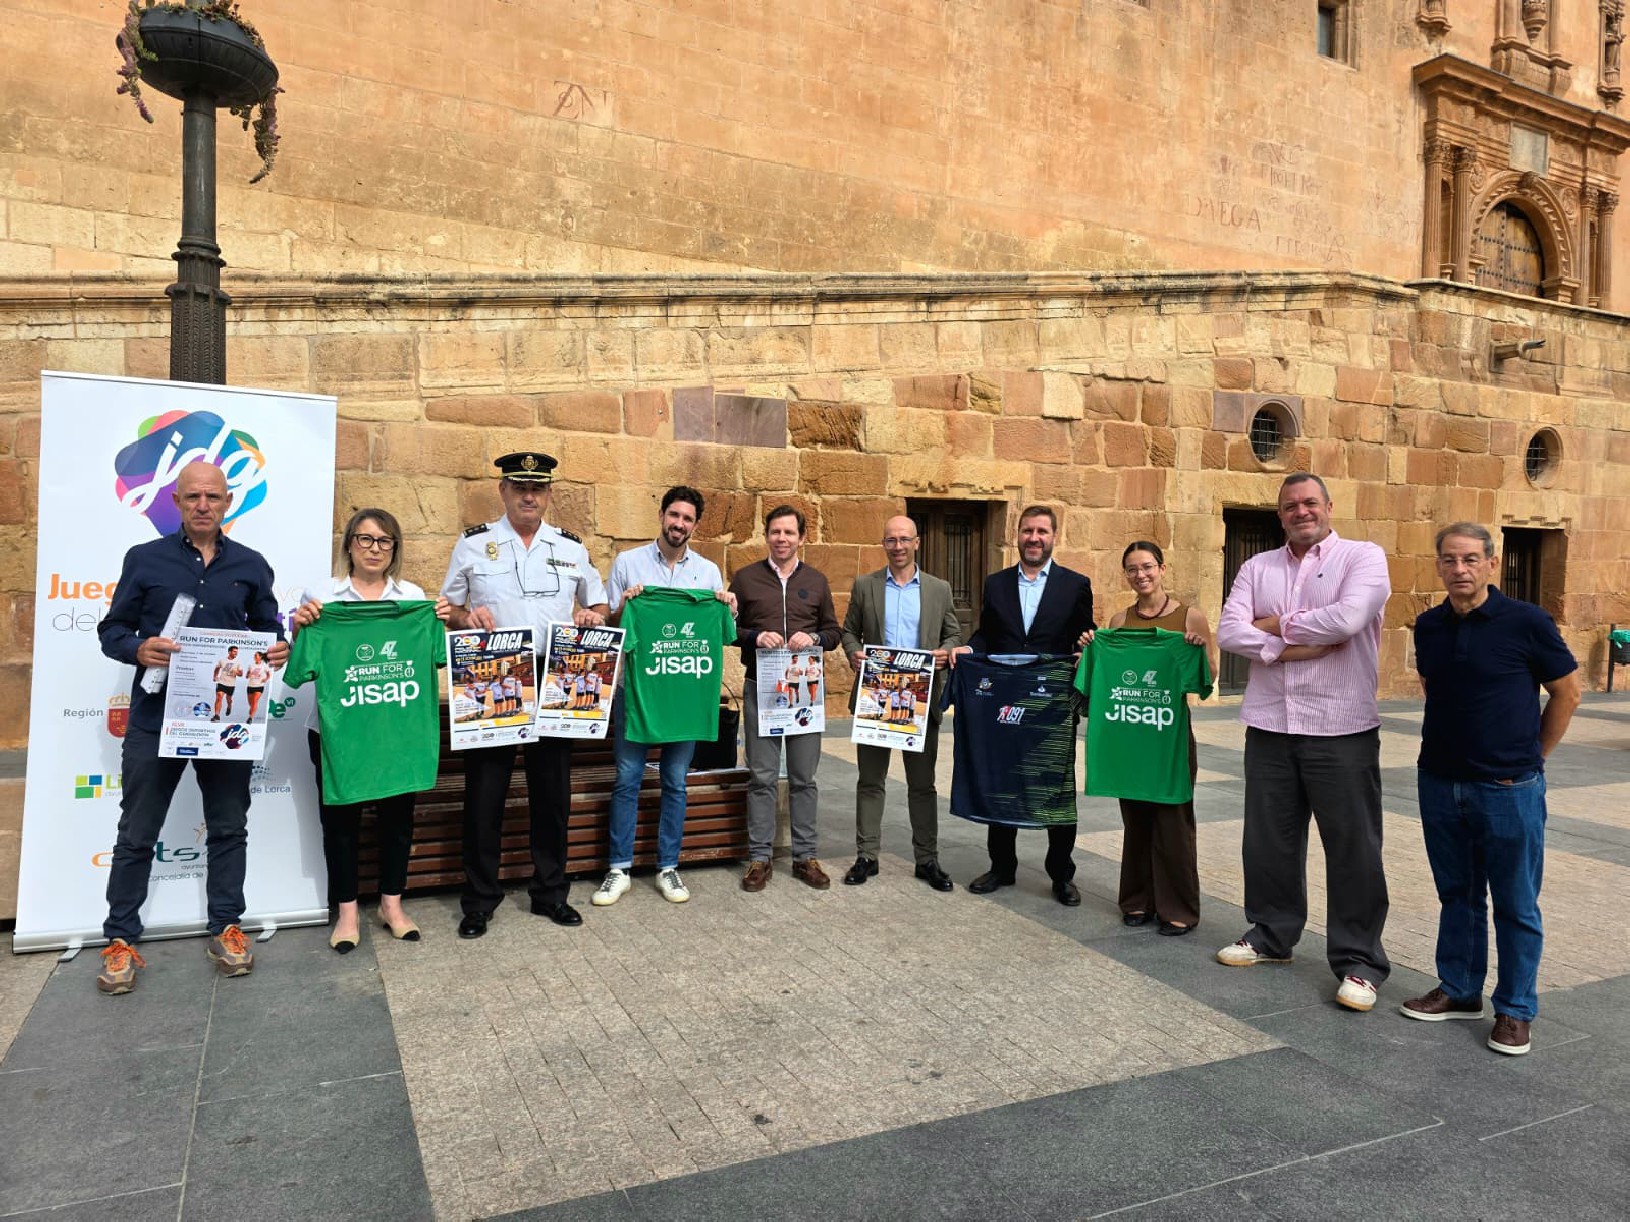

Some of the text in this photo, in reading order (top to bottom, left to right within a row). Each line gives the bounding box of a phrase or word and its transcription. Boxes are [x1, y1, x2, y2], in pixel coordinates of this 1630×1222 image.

[179, 635, 198, 643] RUN
[199, 636, 216, 644] FOR
[217, 638, 268, 647] PARKINSON'S
[486, 632, 523, 651] LORCA
[580, 629, 615, 648] LORCA
[682, 641, 699, 649] FOR
[893, 651, 926, 669] LORCA
[358, 663, 403, 675] RUN FOR
[1123, 689, 1161, 699] RUN FOR
[63, 707, 104, 719] Región
[250, 785, 291, 794] de Lorca
